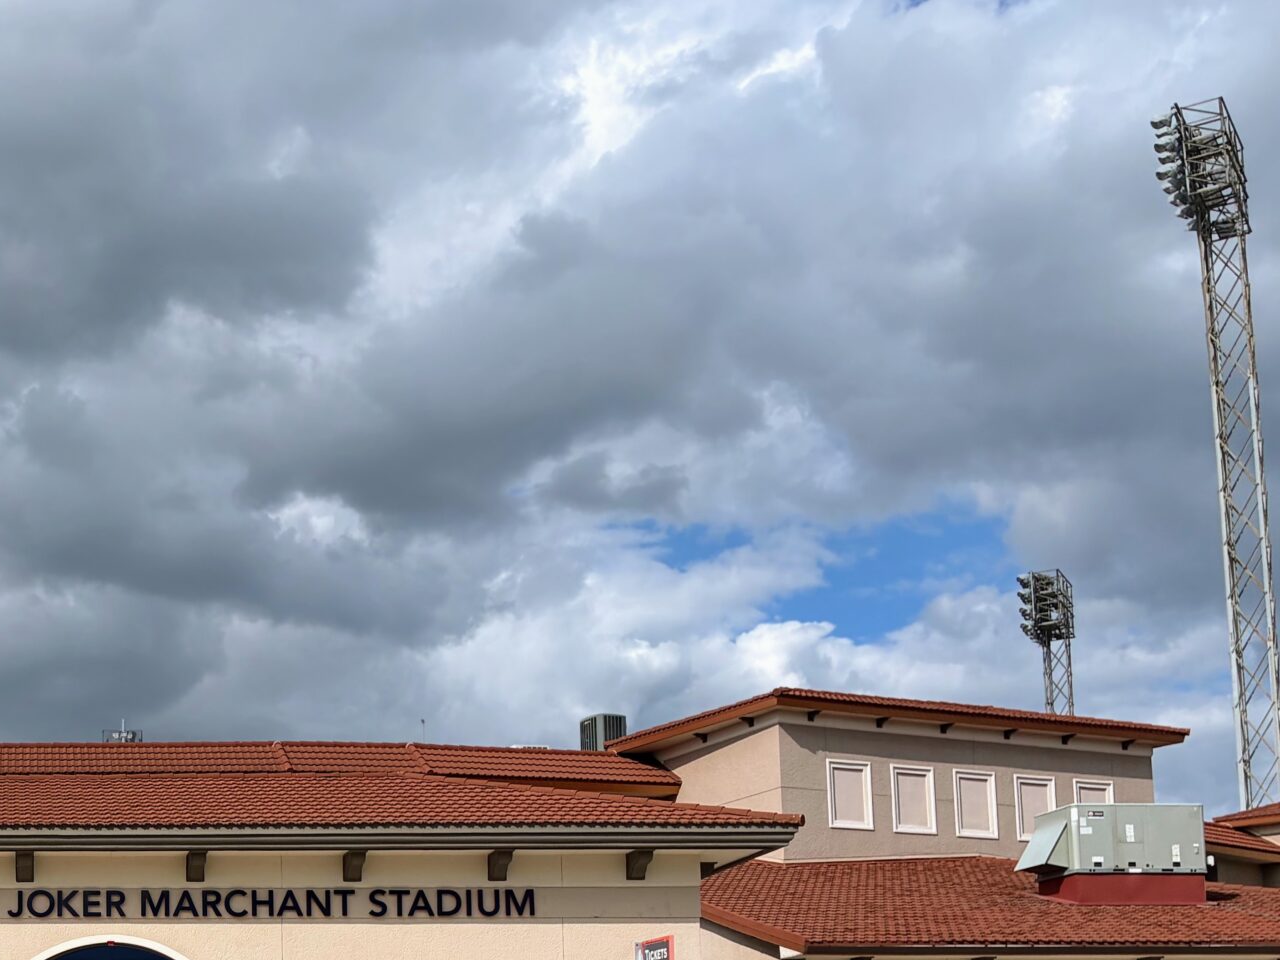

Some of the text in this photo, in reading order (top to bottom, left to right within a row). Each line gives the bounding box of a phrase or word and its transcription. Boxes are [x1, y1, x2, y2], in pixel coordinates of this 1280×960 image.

[6, 889, 128, 919] JOKER
[139, 888, 357, 918] MARCHANT
[368, 888, 537, 918] STADIUM
